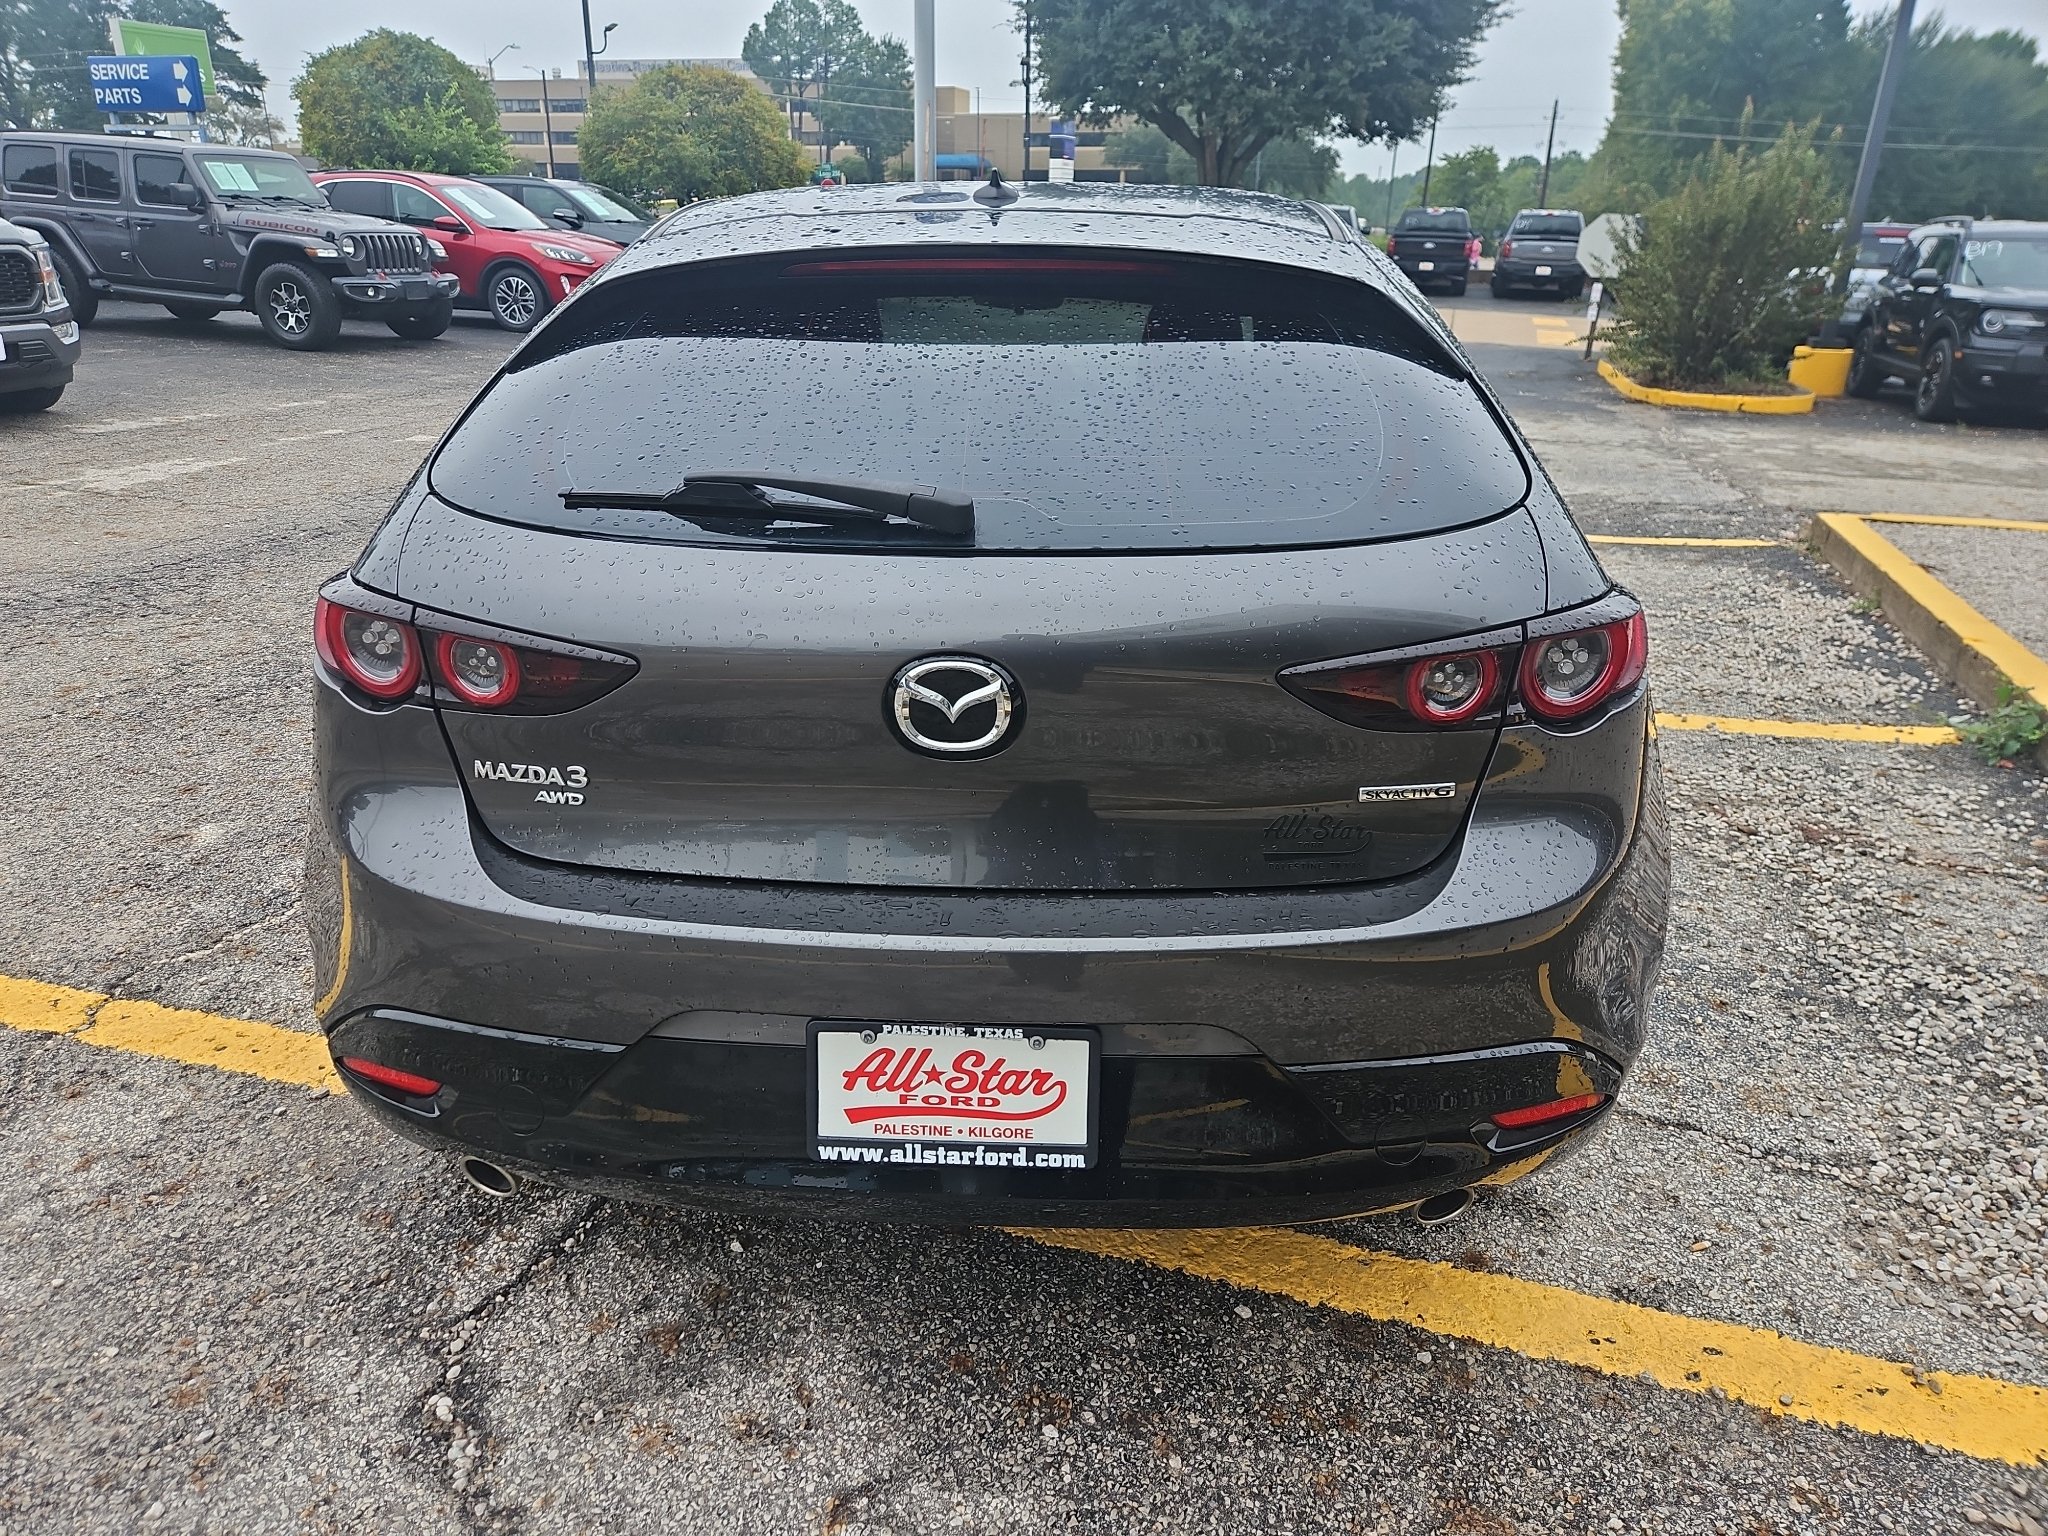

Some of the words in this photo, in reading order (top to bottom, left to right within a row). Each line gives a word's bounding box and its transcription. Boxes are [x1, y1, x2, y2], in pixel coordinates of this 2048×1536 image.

[90, 64, 149, 80] SERVICE
[94, 88, 142, 104] PARTS
[245, 219, 319, 234] RUBICON
[534, 790, 585, 806] AWD
[882, 1024, 970, 1039] PALESTINE,
[974, 1027, 1024, 1039] TEXAS
[842, 1047, 934, 1093] All
[945, 1049, 1067, 1096] Star
[899, 1094, 1002, 1108] FORD
[873, 1123, 953, 1137] PALESTINE
[968, 1127, 1034, 1139] KILGORE
[818, 1144, 1086, 1168] www.allstarford.com
